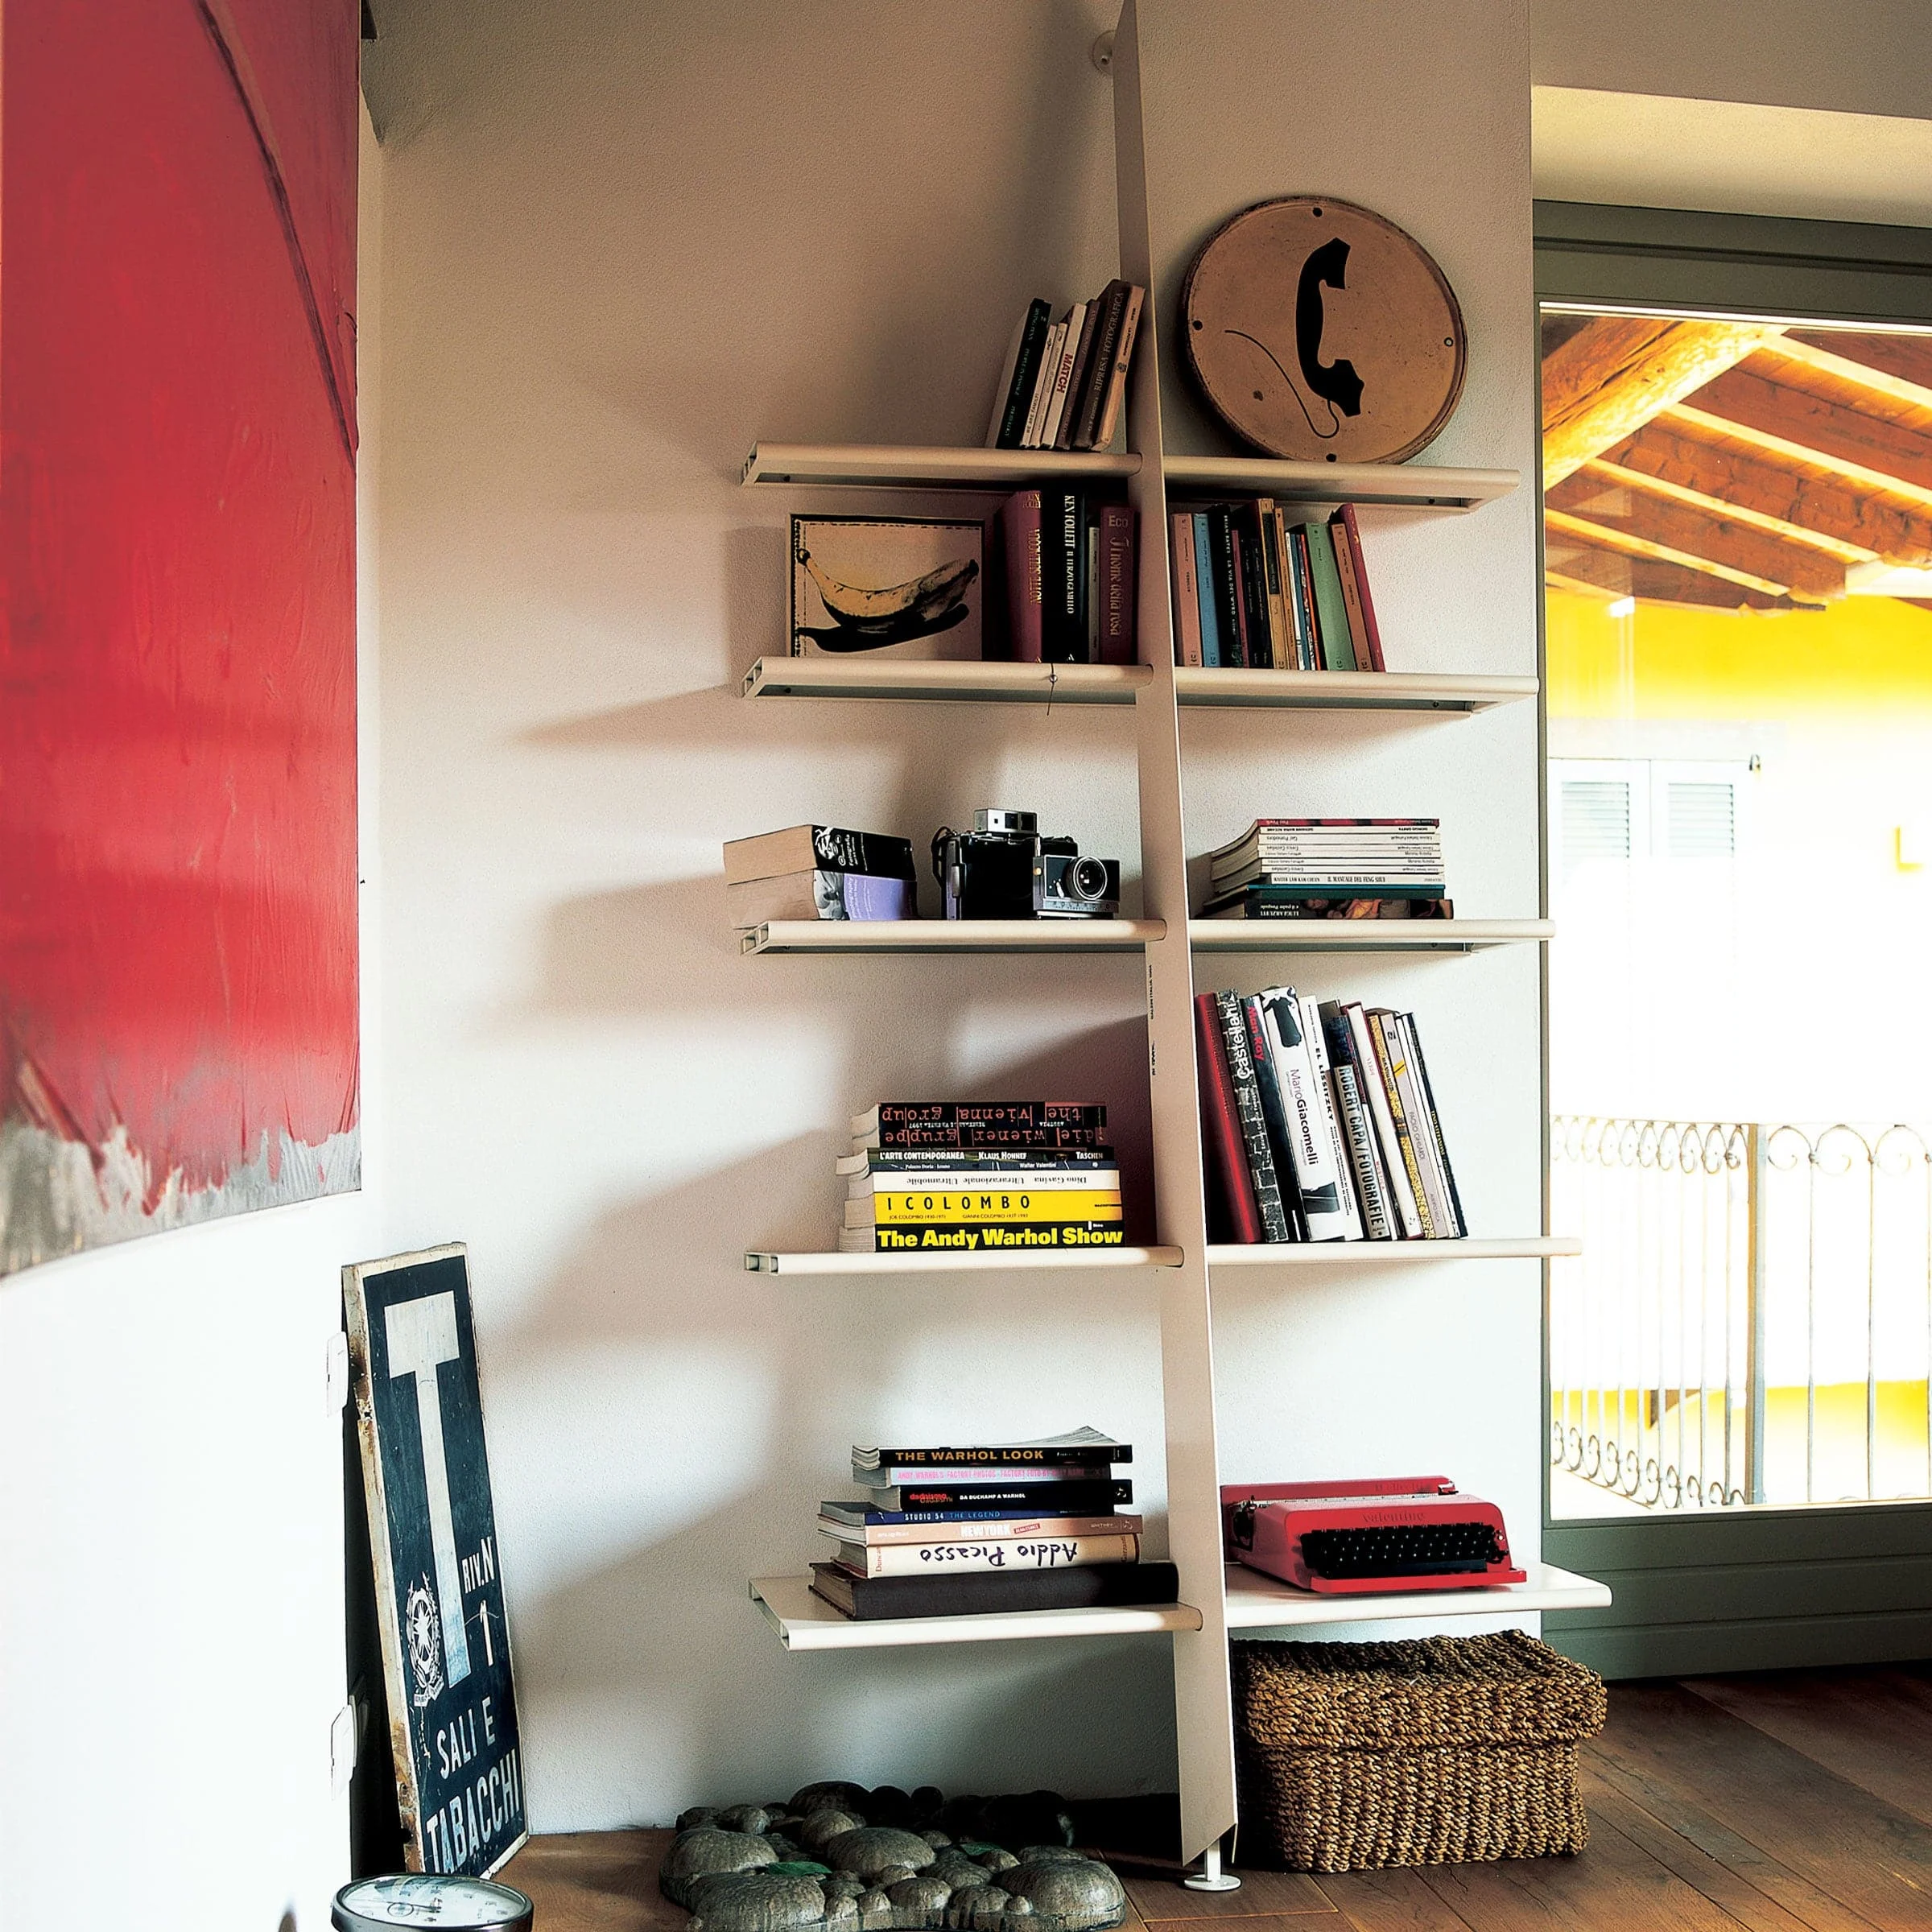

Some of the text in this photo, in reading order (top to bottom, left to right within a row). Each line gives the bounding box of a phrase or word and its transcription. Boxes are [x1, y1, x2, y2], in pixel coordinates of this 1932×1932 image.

[1094, 292, 1124, 392] RIPRESA FOTOGRAFICA
[1056, 353, 1073, 394] MATCH
[1064, 495, 1075, 512] KEN
[1064, 515, 1075, 548] FOLLETT
[1109, 552, 1122, 581] nome
[1030, 576, 1042, 604] NOTTE
[1067, 580, 1075, 613] GEMELLO
[1108, 584, 1122, 609] della
[1109, 612, 1122, 636] rosa
[1228, 1003, 1249, 1080] Castellani
[1248, 1006, 1265, 1061] Man Ray
[1315, 1047, 1323, 1059] EL
[1319, 1063, 1335, 1121] LISSITZKY
[1339, 1067, 1360, 1117] ROBERT
[881, 1107, 1082, 1123] the vienna group
[885, 1129, 1095, 1144] die wiener gruppe
[1350, 1117, 1366, 1146] CAPA
[880, 1151, 1104, 1161] L'ARTE CONTEMPORANEA KLAUS HONNEF TASCHEN
[906, 1178, 958, 1186] Ultramobile
[963, 1177, 1025, 1185] Ultrarazionale
[1034, 1177, 1065, 1186] Gavina
[1356, 1153, 1385, 1225] FOTOGRAFIE
[906, 1195, 1030, 1210] COLOMBO
[877, 1227, 1123, 1249] The Andy Warhol Show
[895, 1450, 1044, 1461] THE WARHOL LOOK
[383, 1290, 472, 1689] T
[968, 1511, 1001, 1519] LEGEND
[1363, 1510, 1425, 1524] valentine
[960, 1525, 983, 1538] NEW
[983, 1524, 1012, 1538] YORK
[920, 1542, 1078, 1567] Addio Picasso
[480, 1600, 494, 1666] 1
[436, 1696, 496, 1780] SALI E
[426, 1748, 521, 1876] TABACCHI
